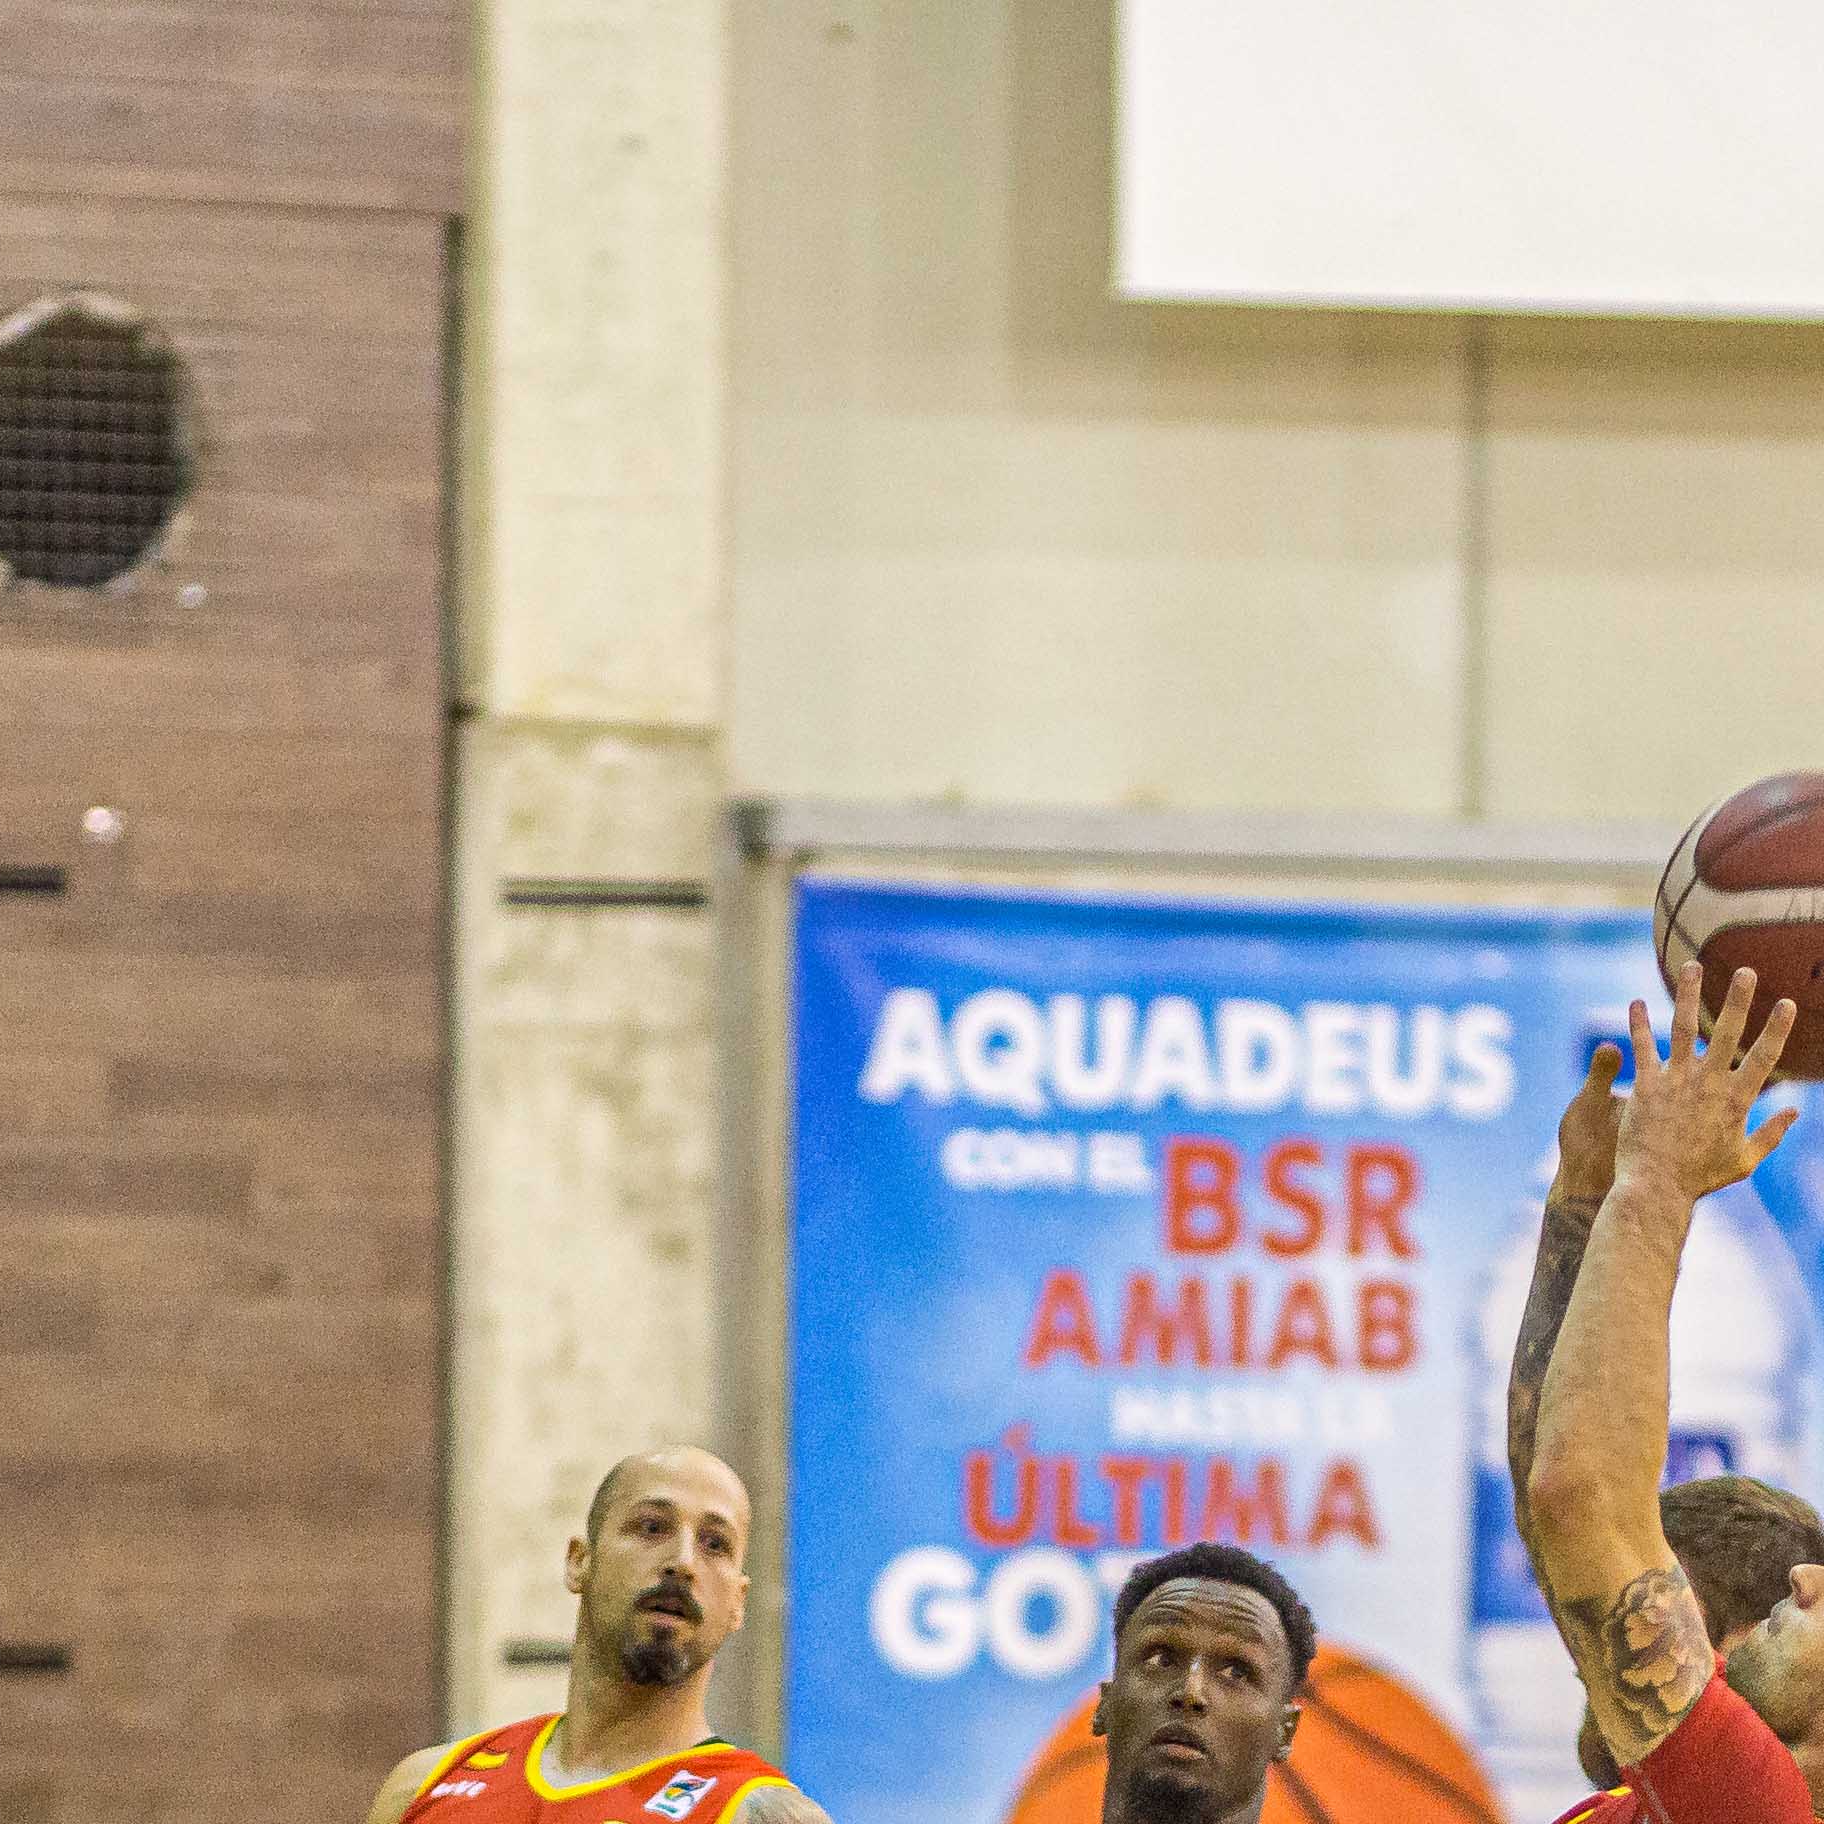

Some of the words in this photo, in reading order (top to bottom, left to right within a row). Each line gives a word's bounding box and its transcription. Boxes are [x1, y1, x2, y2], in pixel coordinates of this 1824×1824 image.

[860, 988, 1517, 1118] AQUADEUS
[1163, 1137, 1421, 1262] BSR
[1026, 1270, 1420, 1374] AMIAB
[963, 1420, 1384, 1550] ÚLTIMA
[872, 1548, 1161, 1678] GO
